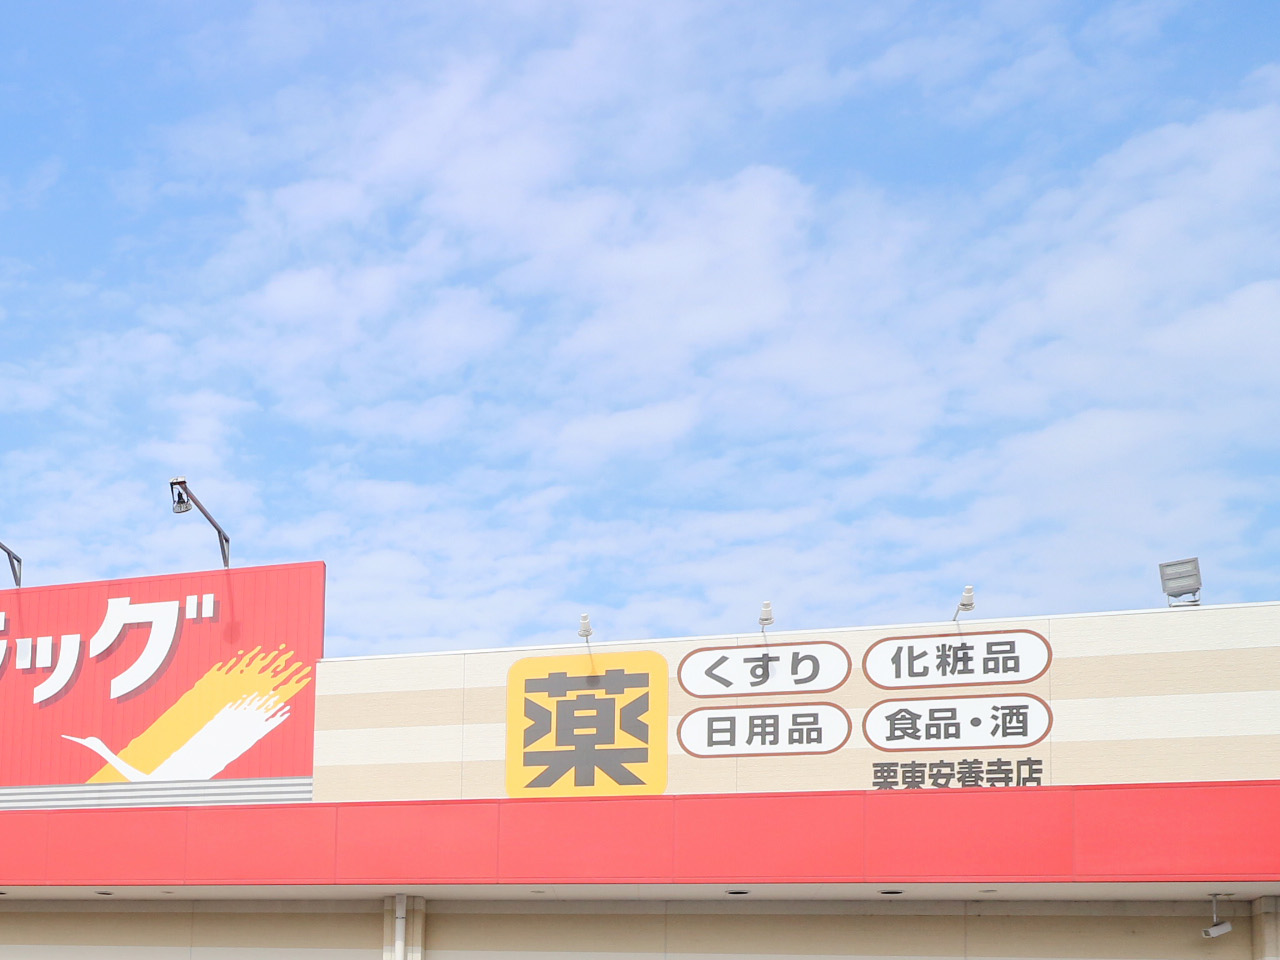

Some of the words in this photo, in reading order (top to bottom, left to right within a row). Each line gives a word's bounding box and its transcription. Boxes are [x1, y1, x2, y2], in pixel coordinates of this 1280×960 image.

[704, 651, 822, 688] くすり
[890, 641, 1021, 679] 化粧品
[523, 669, 650, 788] 薬
[706, 712, 823, 748] 日用品
[885, 704, 1030, 743] 食品・酒
[871, 757, 1043, 790] 栗東安養寺店
